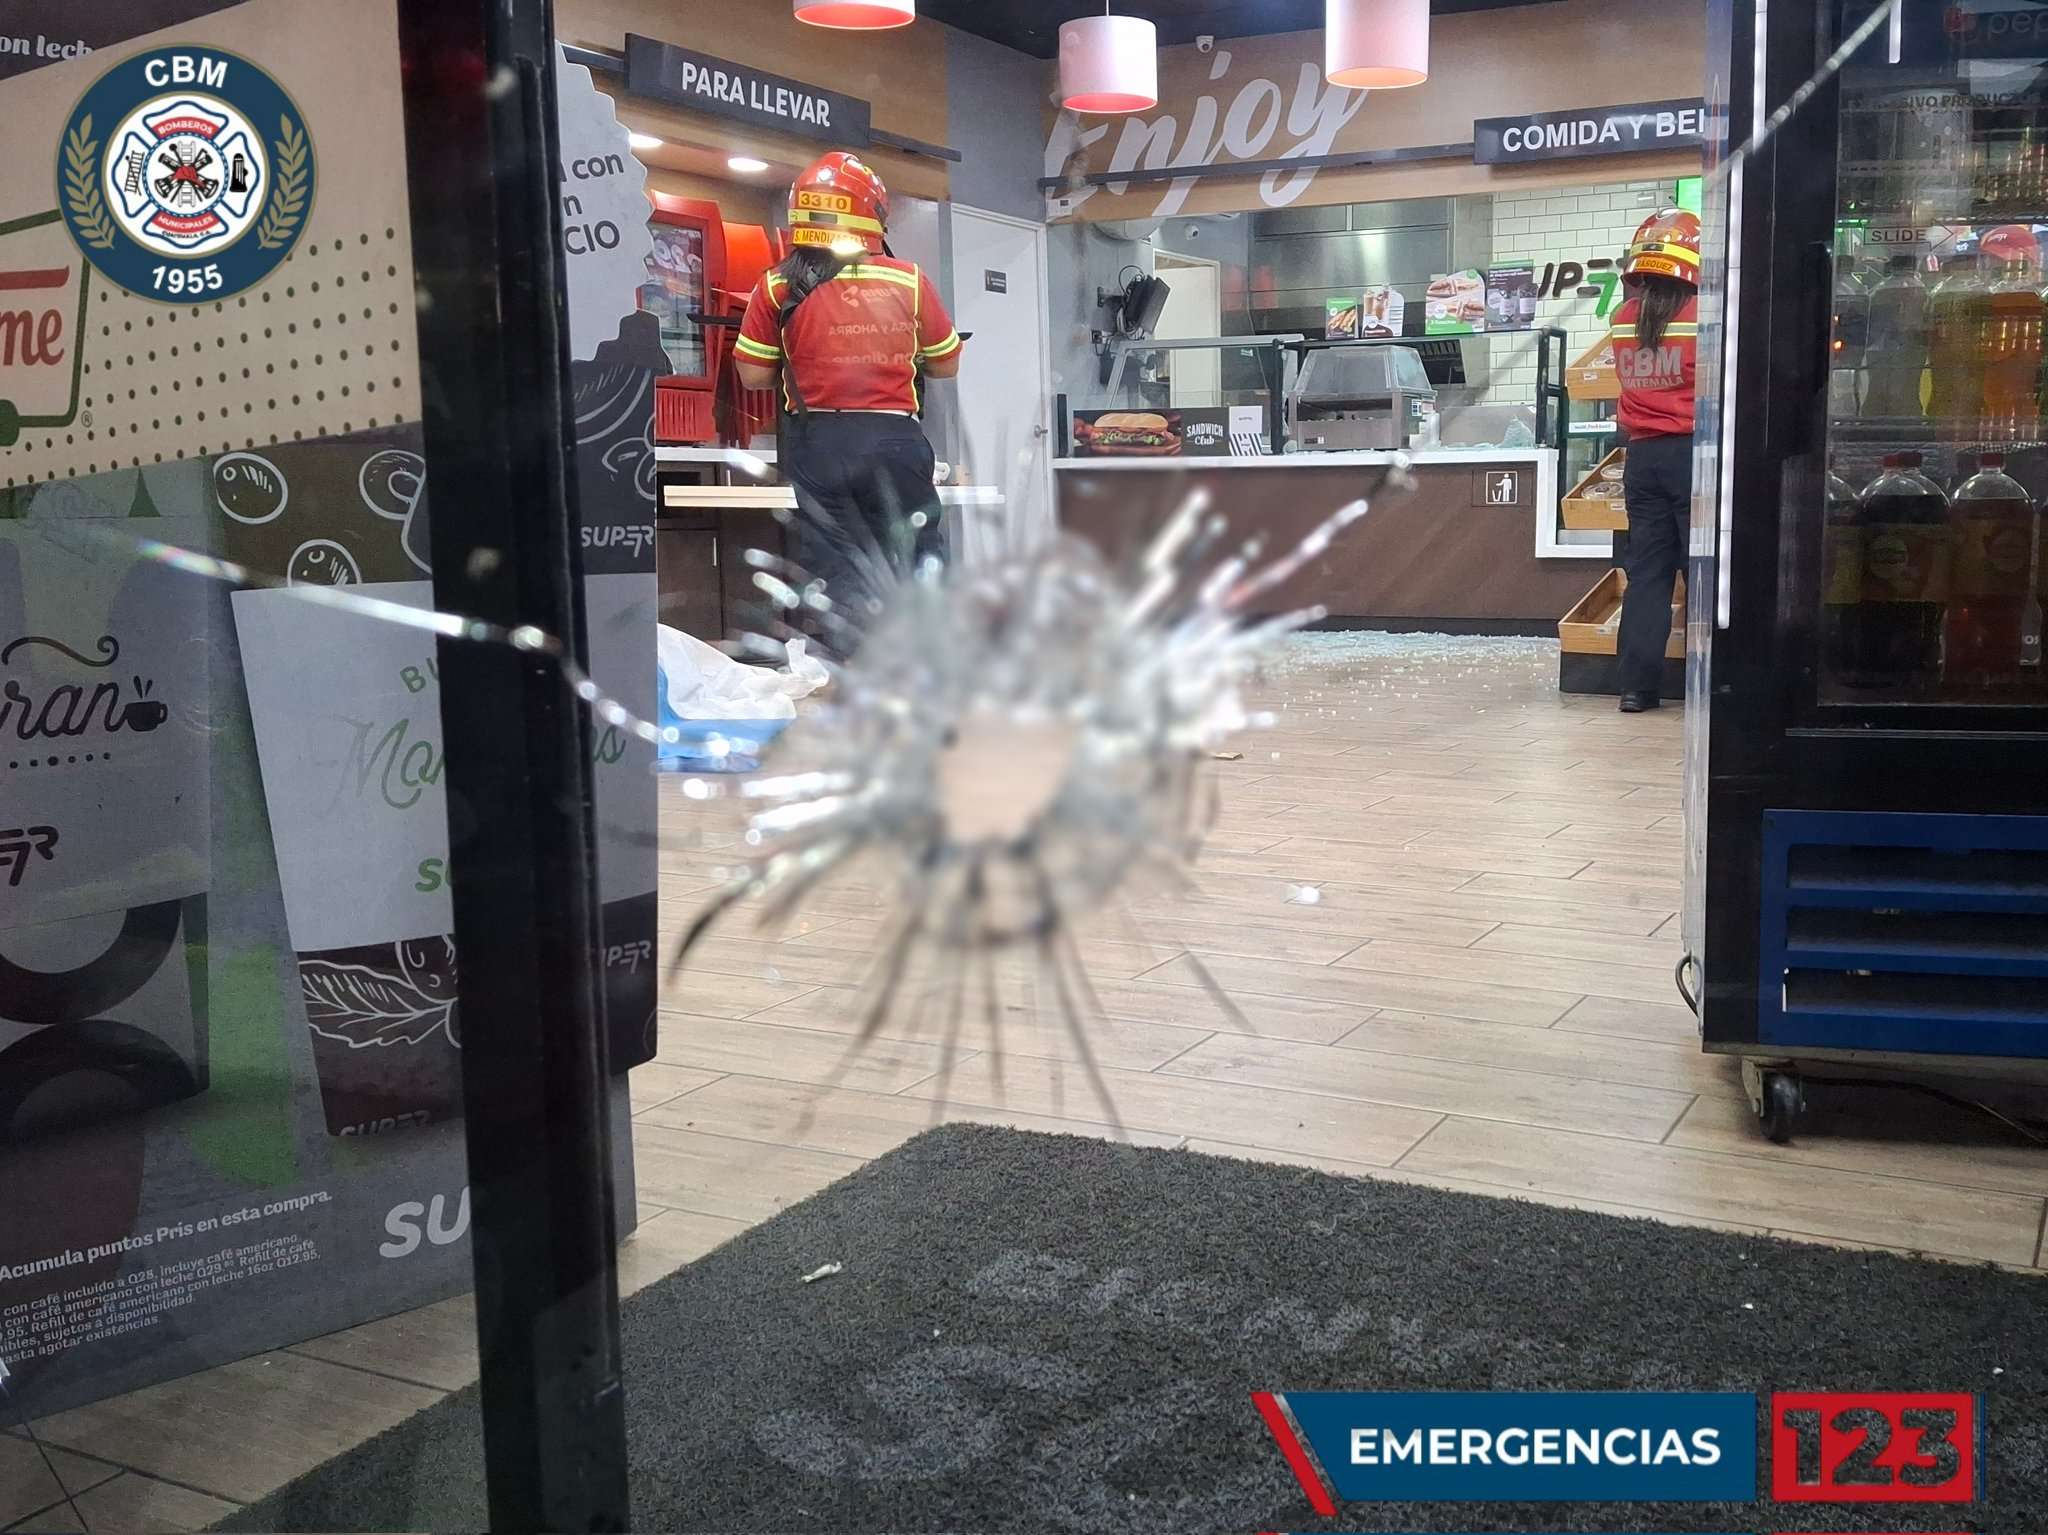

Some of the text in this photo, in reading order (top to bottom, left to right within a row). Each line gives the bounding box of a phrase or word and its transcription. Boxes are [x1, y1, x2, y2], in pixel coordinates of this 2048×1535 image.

[682, 61, 831, 127] PARA LLEVAR
[1502, 108, 1705, 152] COMIDA Y BE
[572, 153, 624, 180] con
[800, 192, 848, 210] 3310
[1870, 229, 1926, 243] SLIDE
[1619, 346, 1682, 377] CBM
[1186, 422, 1224, 437] SANDWICH
[1194, 435, 1215, 446] Club
[0, 1190, 333, 1281] Acumula puntos Pris en esta compra.
[4, 1303, 28, 1316] con
[31, 1291, 60, 1309] café
[160, 1257, 204, 1277] Incluye
[207, 1248, 233, 1265] café
[235, 1233, 298, 1257] americano
[5, 1315, 29, 1328] con
[32, 1304, 61, 1320] café
[65, 1287, 133, 1312] americano
[135, 1281, 158, 1295] con
[160, 1272, 194, 1288] leche
[239, 1249, 270, 1267] Refill
[272, 1245, 287, 1258] de
[289, 1239, 315, 1255] café
[31, 1315, 66, 1333] Refill
[69, 1311, 85, 1324] de
[87, 1302, 116, 1319] café
[119, 1286, 185, 1310] americano
[187, 1279, 210, 1292] con
[212, 1268, 244, 1285] leche
[248, 1261, 274, 1277] 16oz
[44, 1323, 92, 1342] sujetos
[3, 1350, 35, 1363] asta
[38, 1335, 83, 1355] agotar
